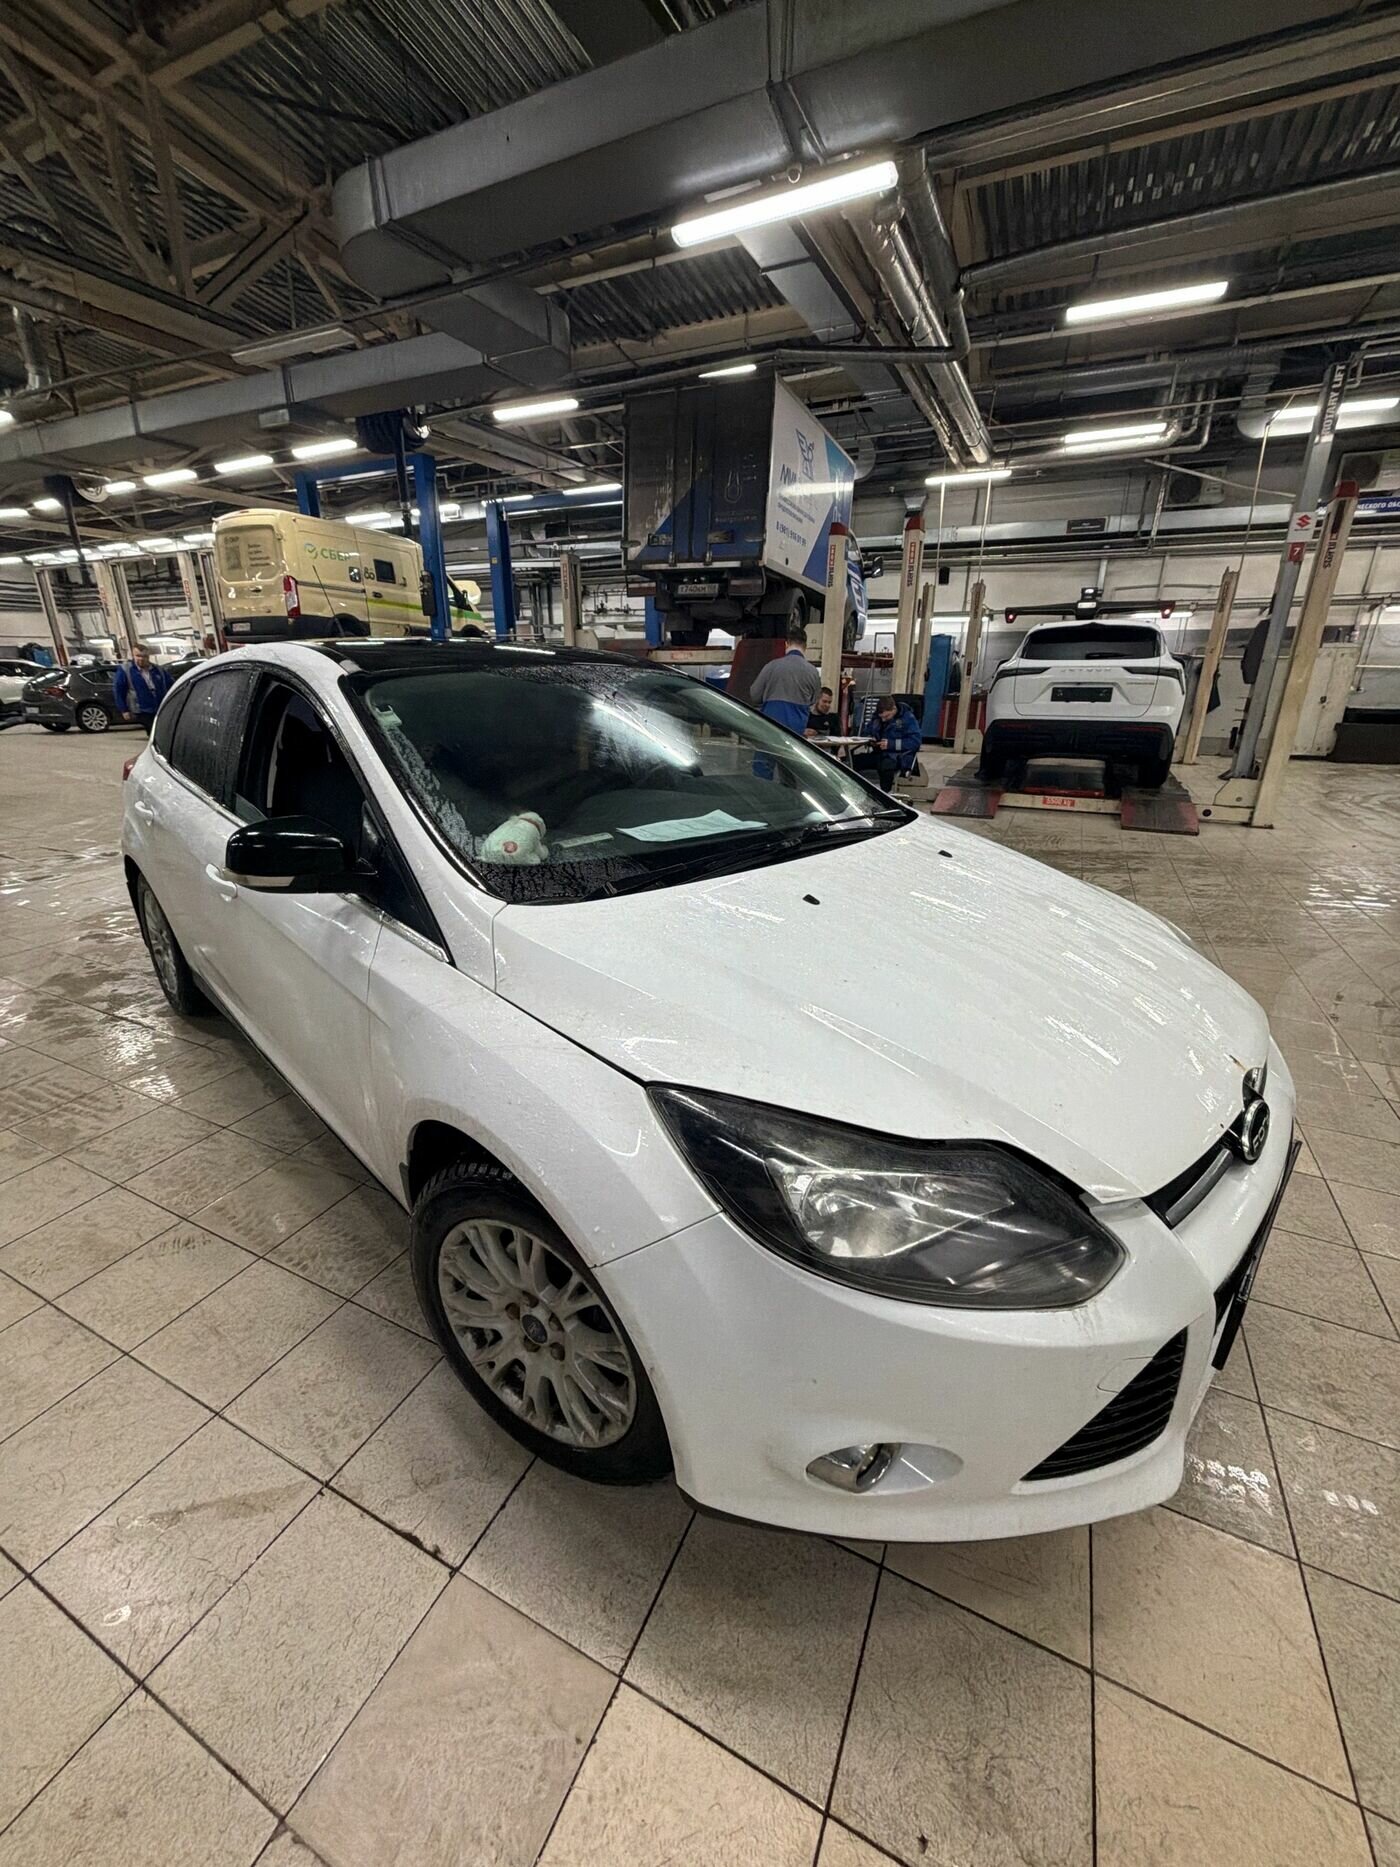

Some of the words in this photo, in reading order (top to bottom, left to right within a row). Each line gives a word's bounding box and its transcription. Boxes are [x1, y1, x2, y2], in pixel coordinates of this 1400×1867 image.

[1321, 390, 1340, 437] ROTARY
[1331, 364, 1346, 389] LIFT
[1293, 547, 1301, 556] 7
